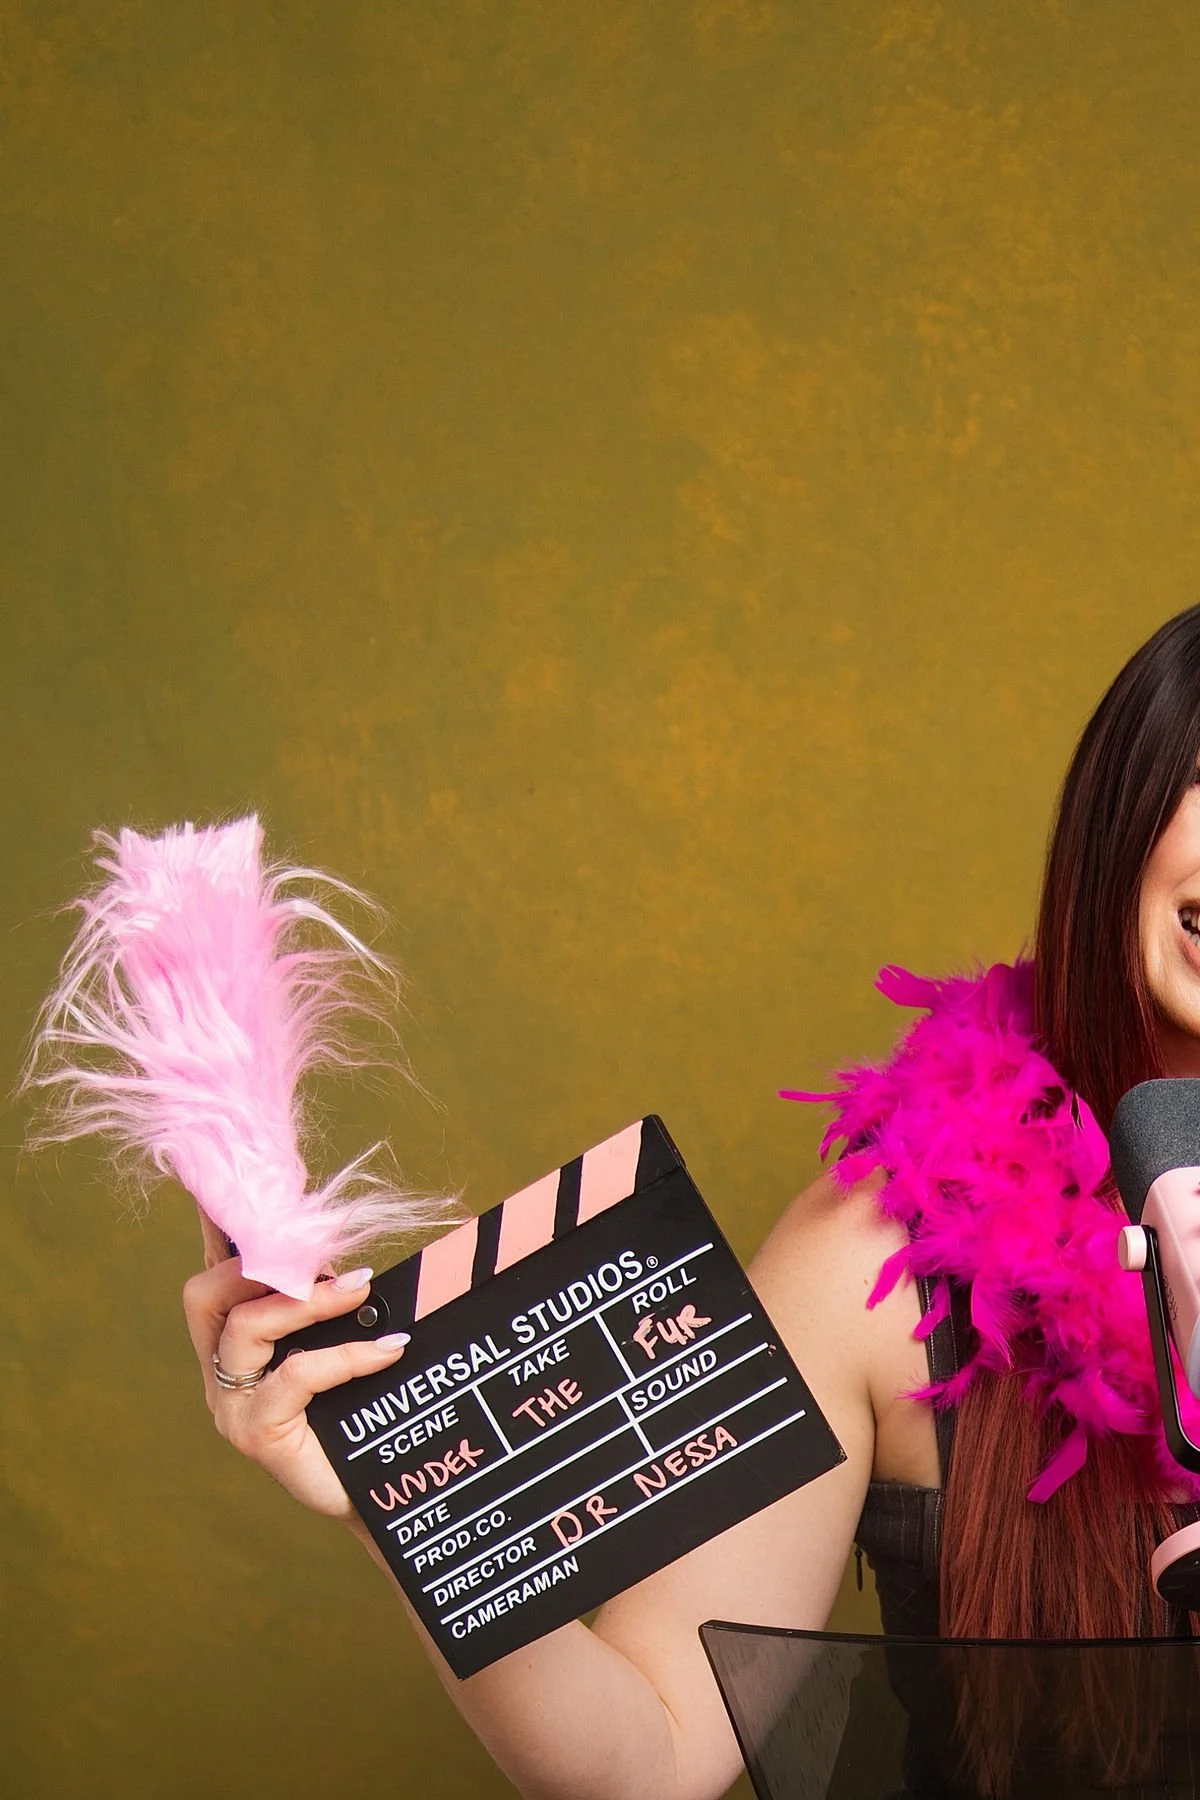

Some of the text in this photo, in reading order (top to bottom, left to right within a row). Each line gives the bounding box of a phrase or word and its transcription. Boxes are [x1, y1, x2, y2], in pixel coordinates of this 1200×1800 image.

[631, 1267, 697, 1315] ROLL
[339, 1334, 511, 1443] UNIVERSAL
[507, 1338, 570, 1386] TAKE
[631, 1349, 718, 1411] SOUND
[369, 1304, 712, 1511] UNDER THE FUR
[378, 1404, 459, 1464] SCENE
[550, 1425, 738, 1548] DR NESSA
[396, 1502, 451, 1545] DATE
[413, 1509, 513, 1574] PROD.CO.
[433, 1536, 537, 1607] DIRECTOR
[451, 1555, 579, 1639] CAMERAMAN
